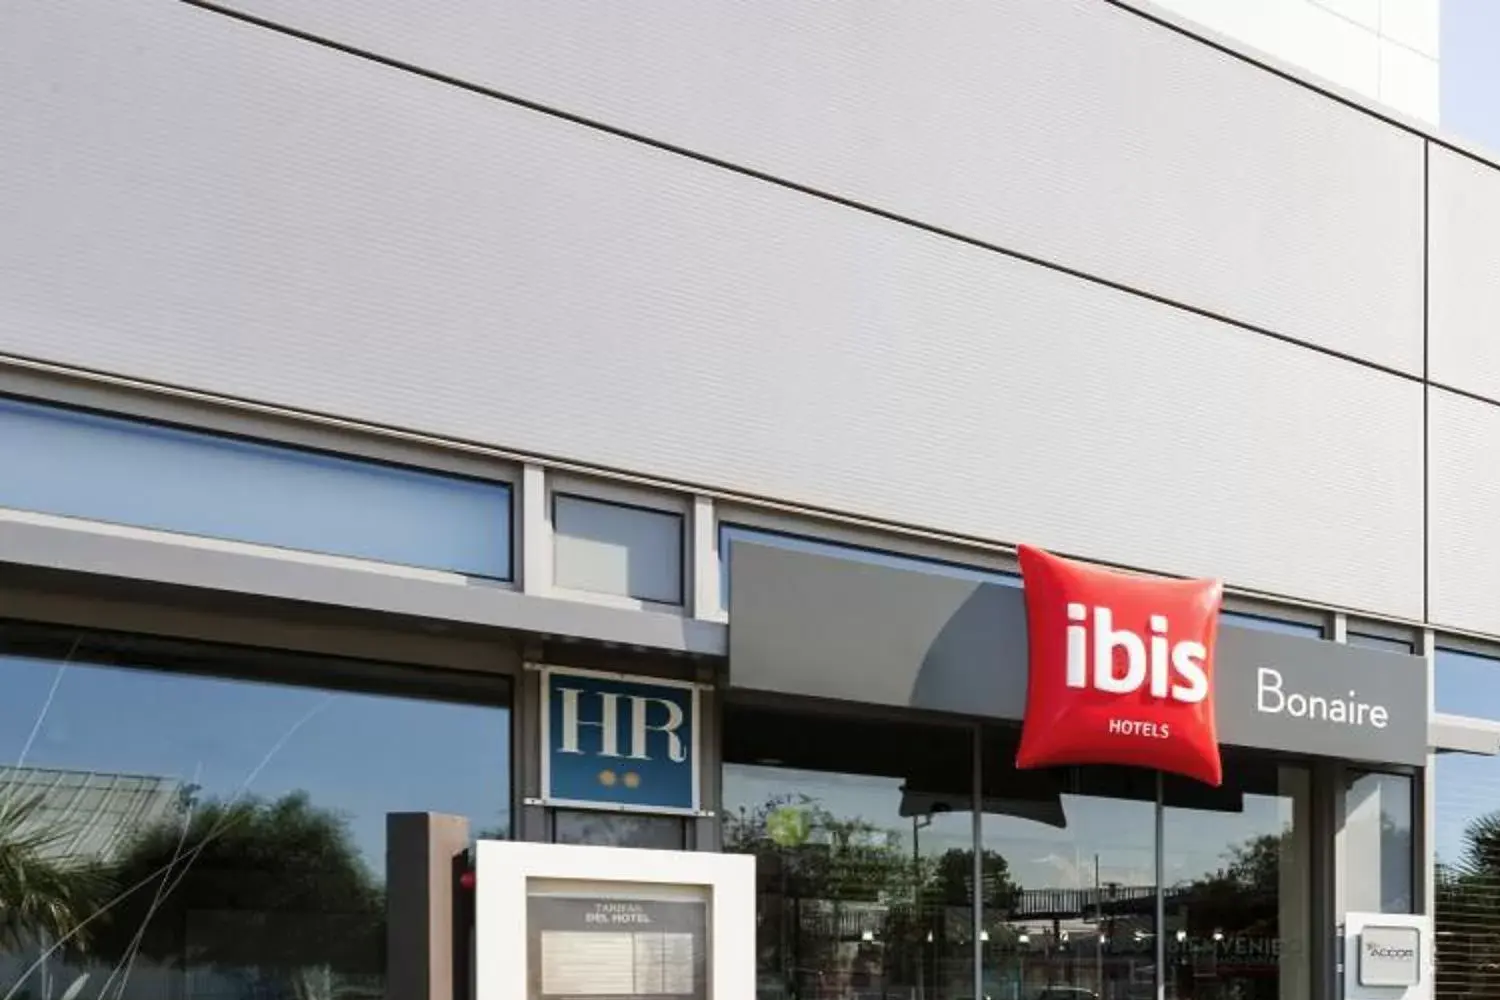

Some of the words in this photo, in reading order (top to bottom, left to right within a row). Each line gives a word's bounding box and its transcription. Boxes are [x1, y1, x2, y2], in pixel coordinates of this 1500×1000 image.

[1065, 602, 1209, 703] ibis
[556, 687, 687, 763] HR
[1108, 719, 1170, 739] HOTELS
[1256, 667, 1389, 729] Bonaire
[611, 913, 652, 924] HOTEL
